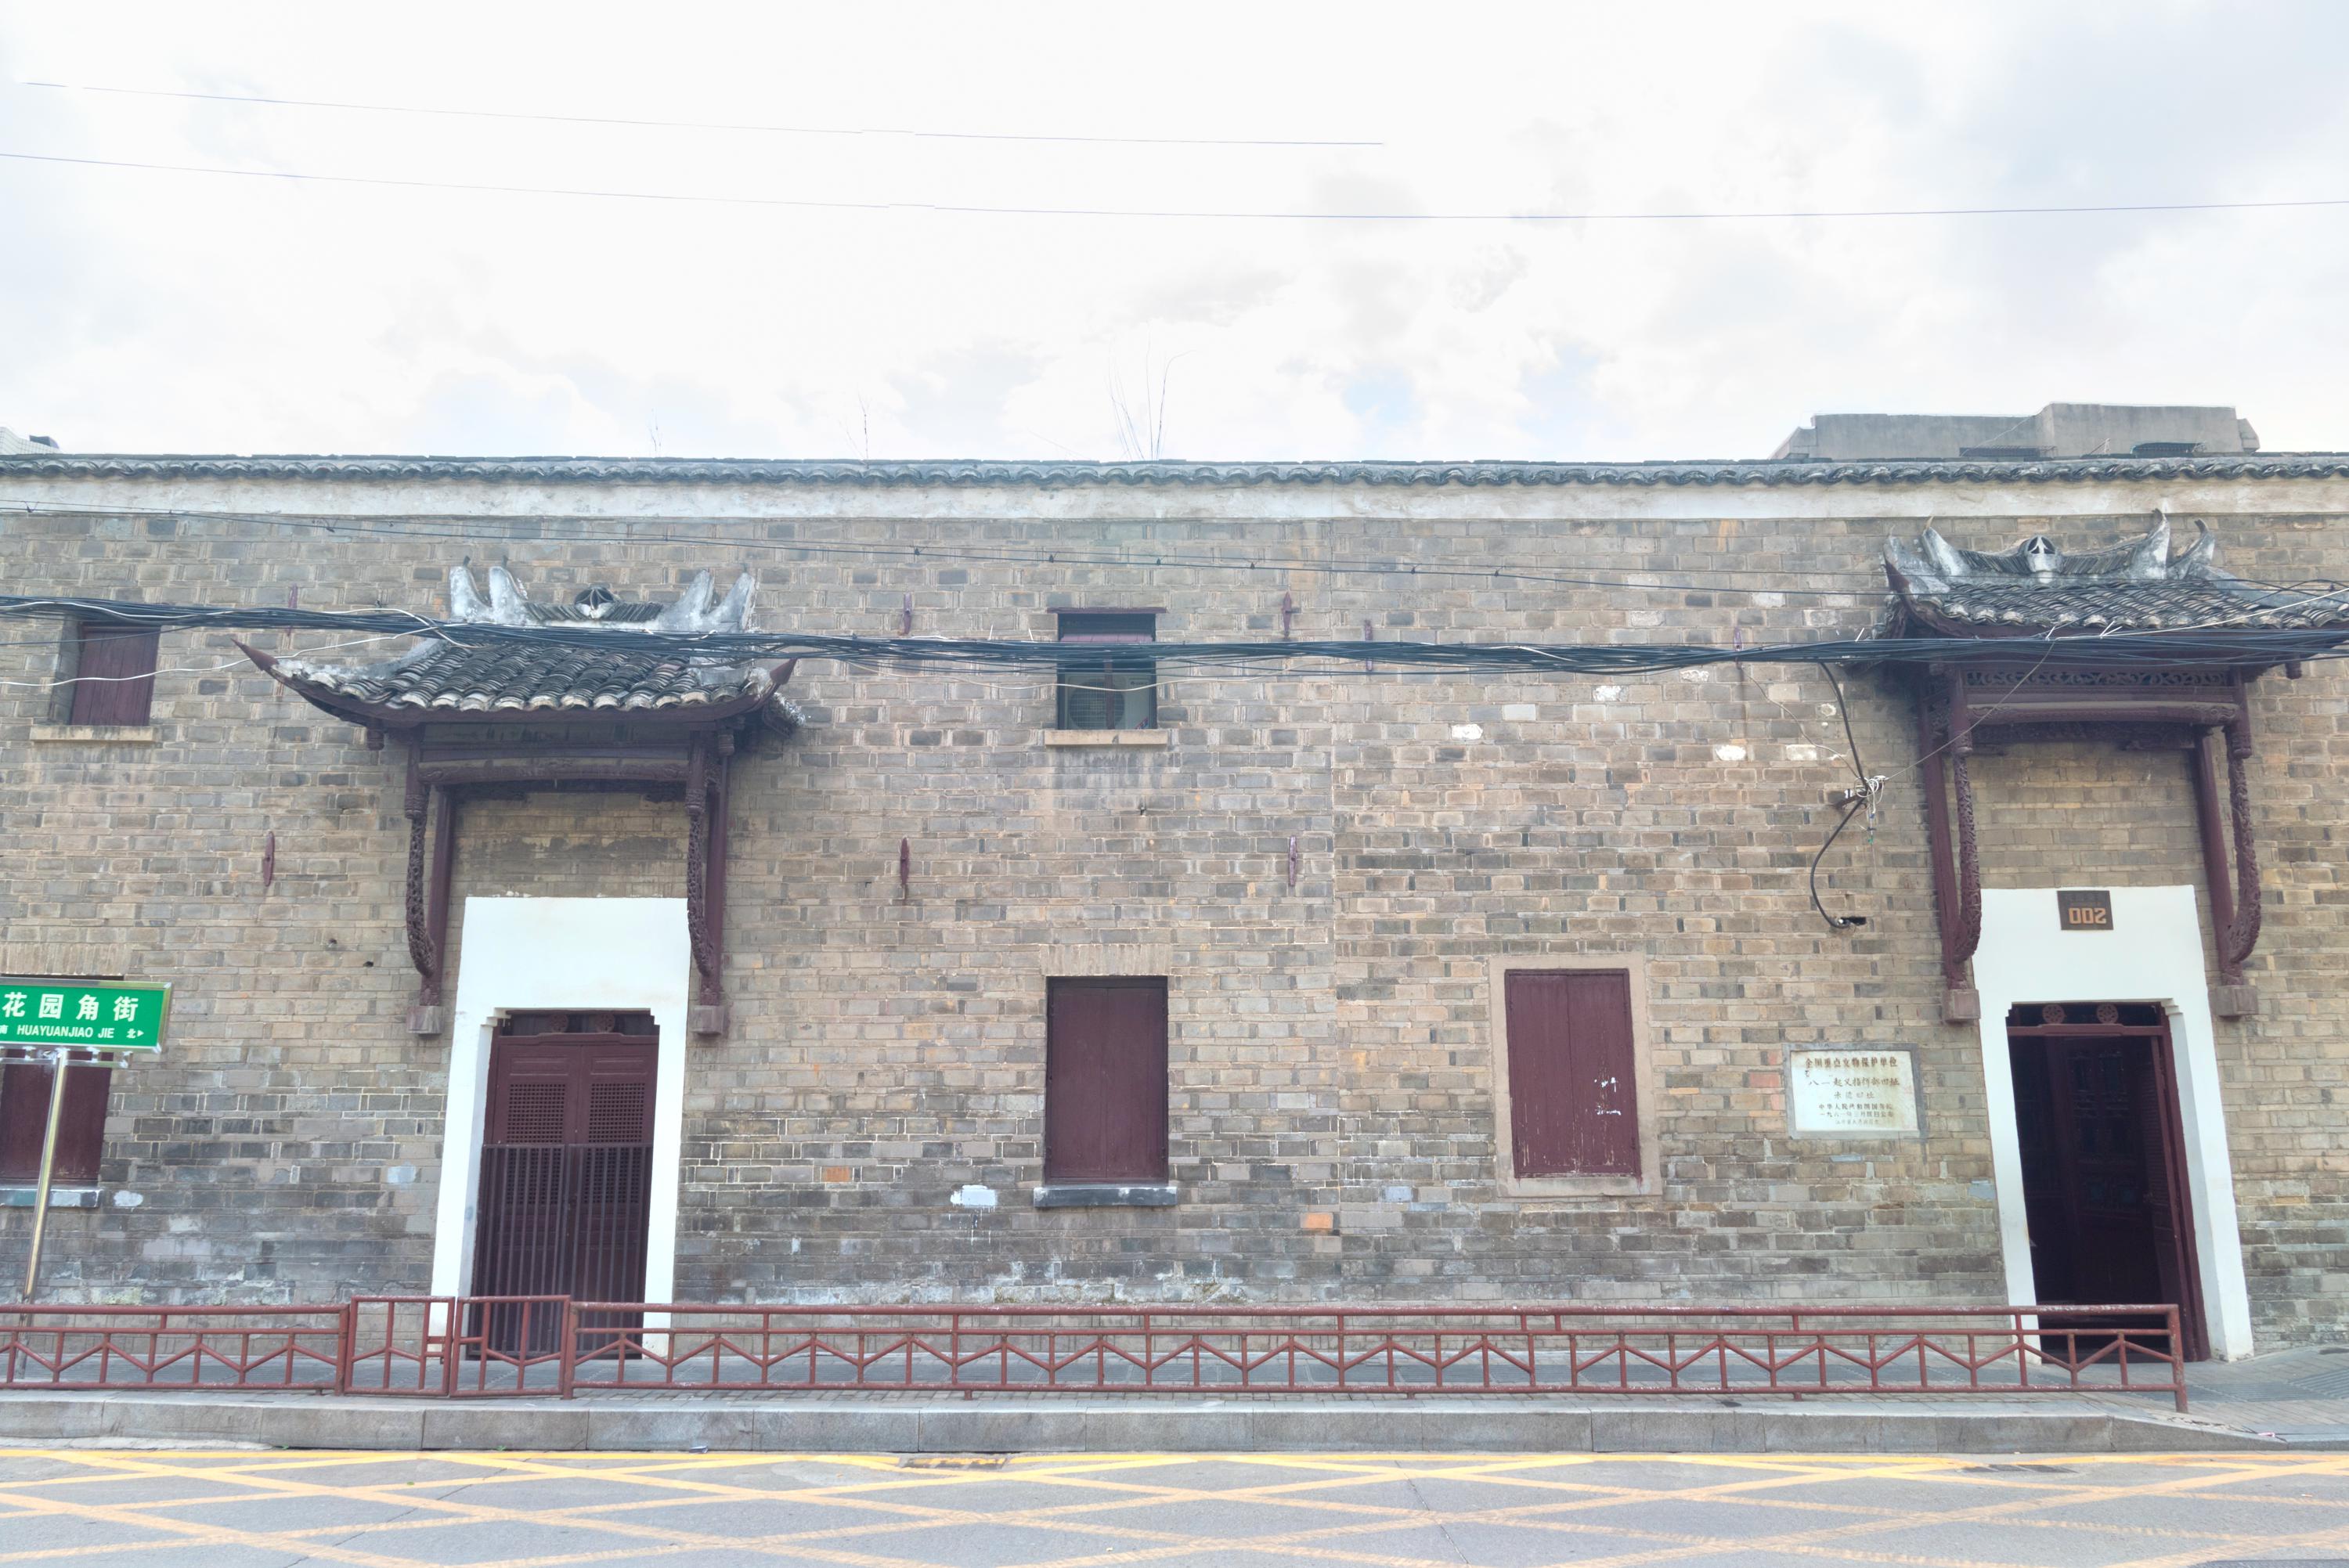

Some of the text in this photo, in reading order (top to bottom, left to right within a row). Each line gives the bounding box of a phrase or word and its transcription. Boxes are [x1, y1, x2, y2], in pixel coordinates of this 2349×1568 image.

[2068, 907, 2107, 925] 002
[2, 991, 139, 1022] 花园角街
[16, 1025, 93, 1038] HUAYUANJIAO
[98, 1027, 115, 1039] JIE
[126, 1028, 136, 1039] 北
[1805, 1057, 1899, 1069] 全国重点文物保护单位
